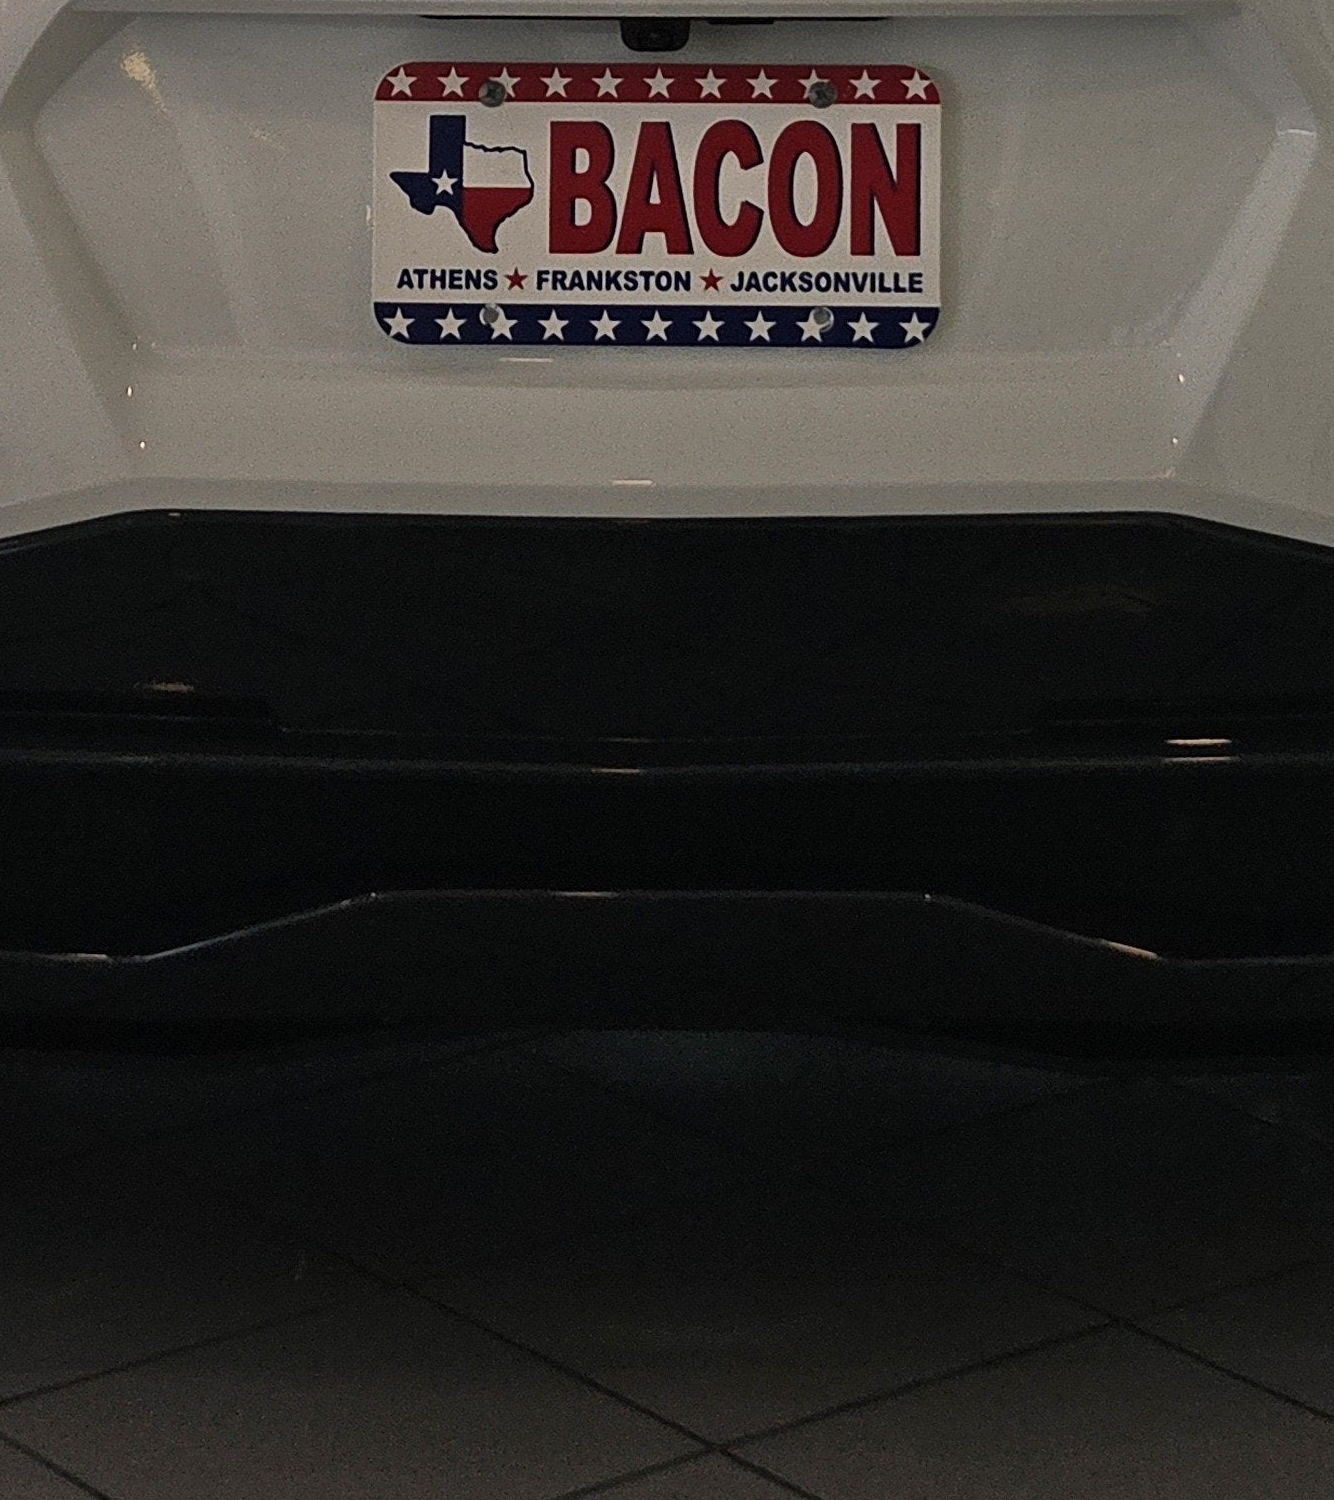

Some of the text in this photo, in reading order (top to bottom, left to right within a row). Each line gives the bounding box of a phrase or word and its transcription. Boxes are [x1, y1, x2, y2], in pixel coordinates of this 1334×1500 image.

[549, 119, 922, 258] BACON
[397, 268, 924, 295] ATHENS FRANKSTON JACKSONVILLE
